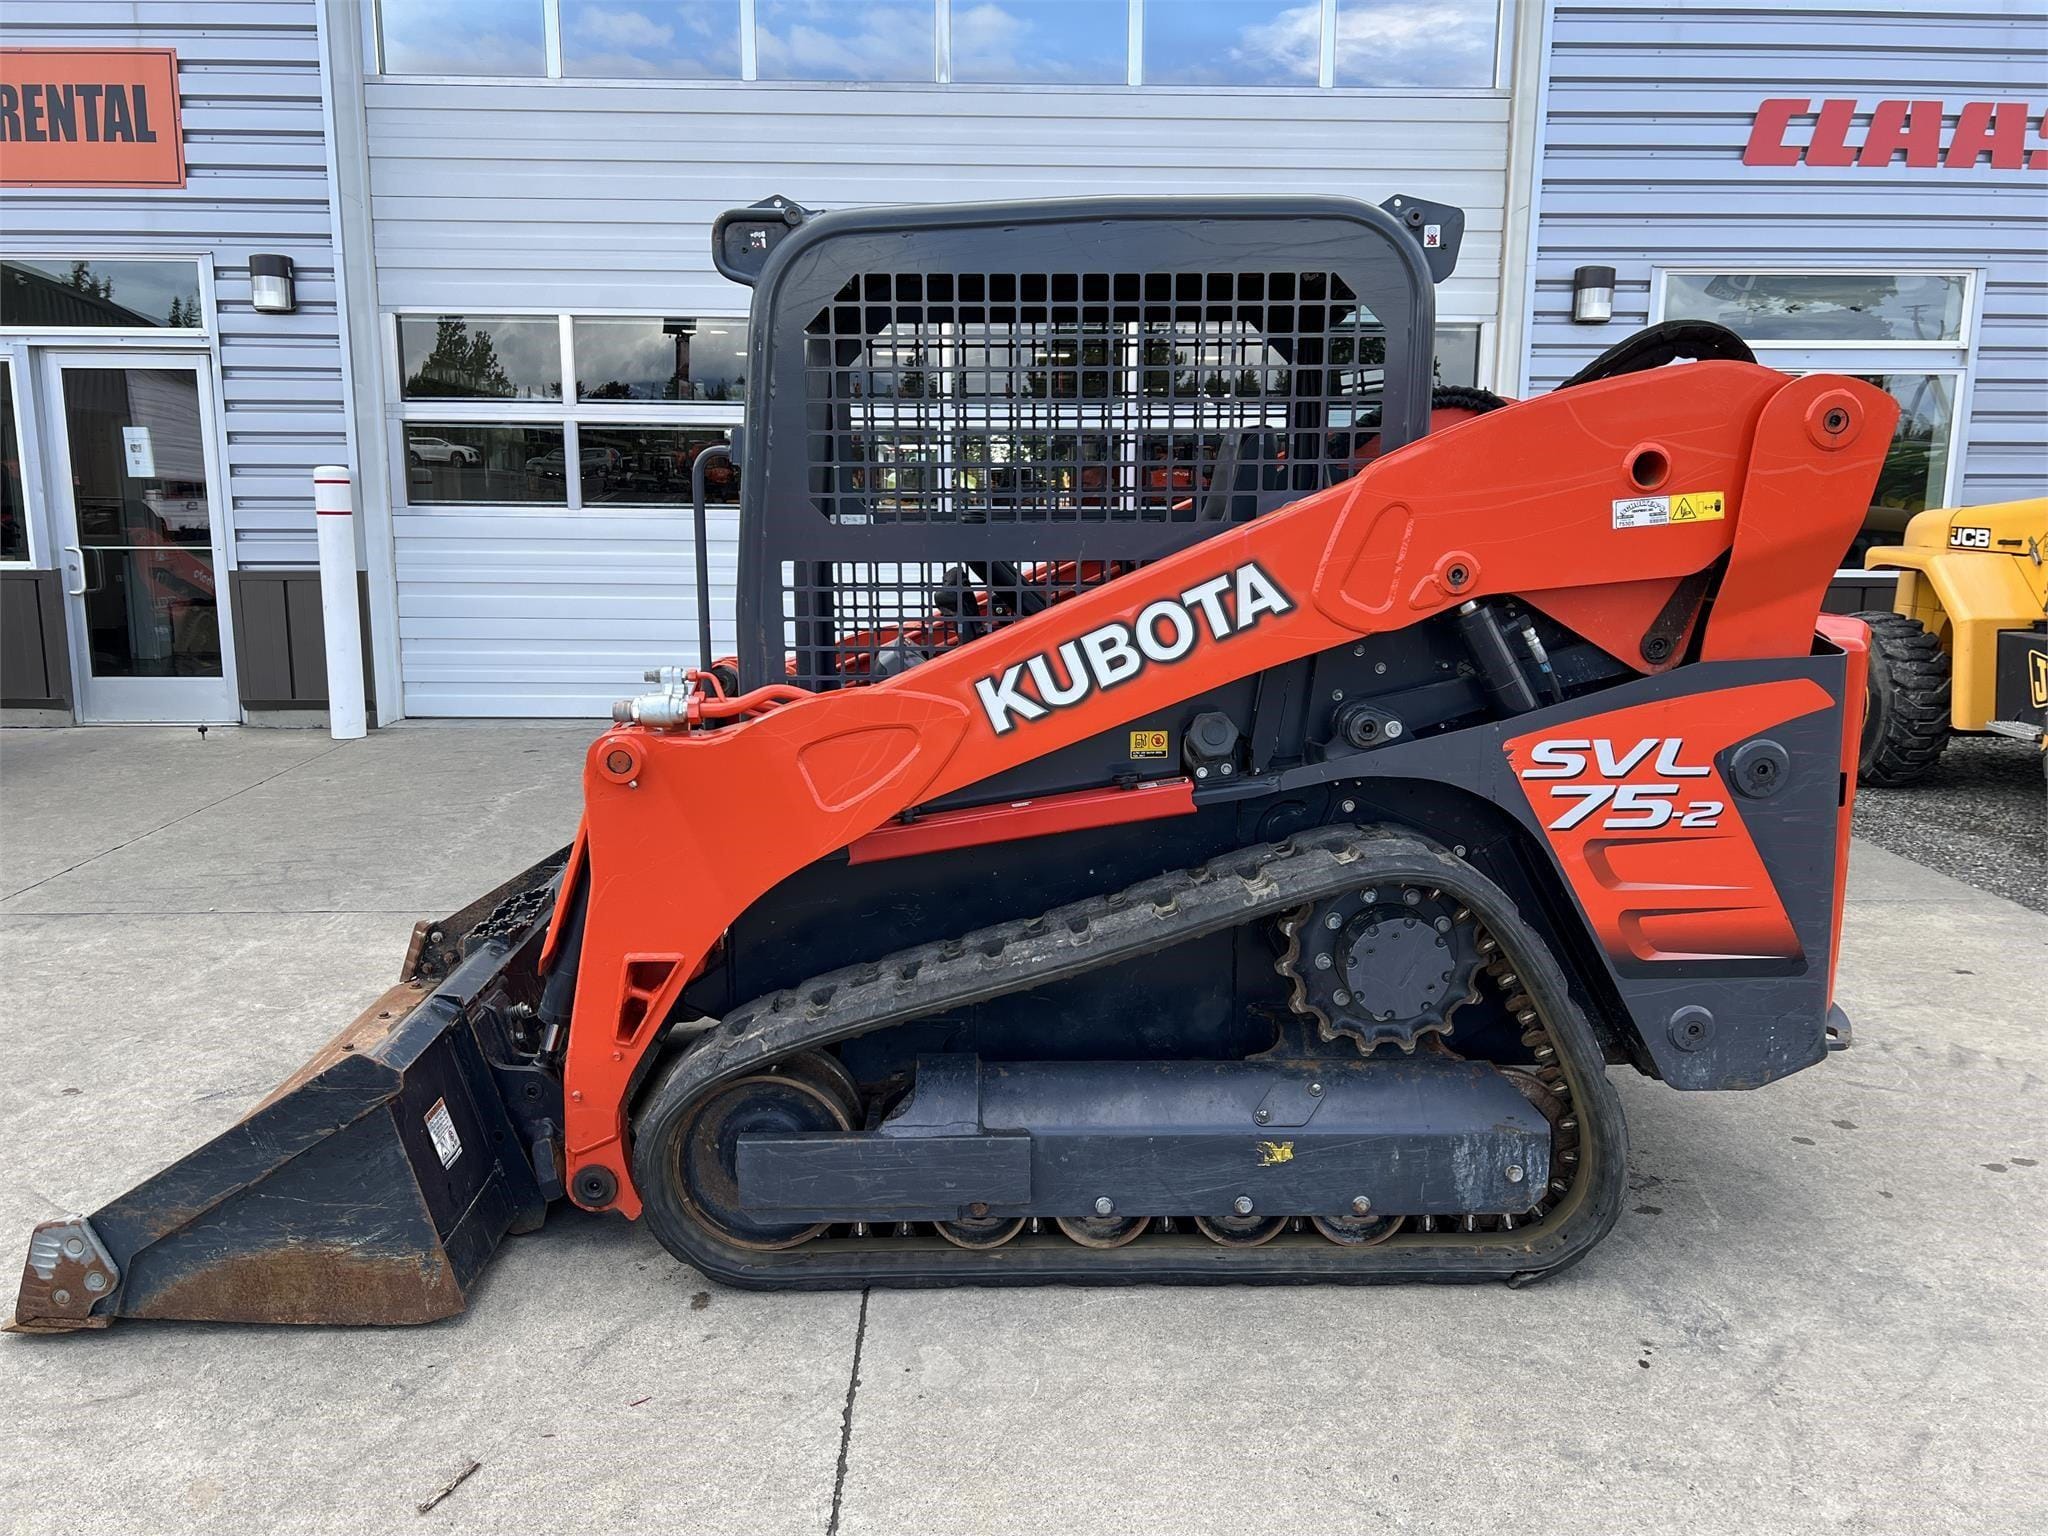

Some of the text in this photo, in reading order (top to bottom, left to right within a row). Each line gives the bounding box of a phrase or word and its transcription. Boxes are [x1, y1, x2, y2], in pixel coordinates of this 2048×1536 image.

[0, 84, 157, 143] RENTAL
[1950, 528, 1990, 547] JCB
[974, 562, 1293, 735] KUBOTA
[1521, 738, 1712, 779] SVL
[1547, 784, 1725, 831] 75-2
